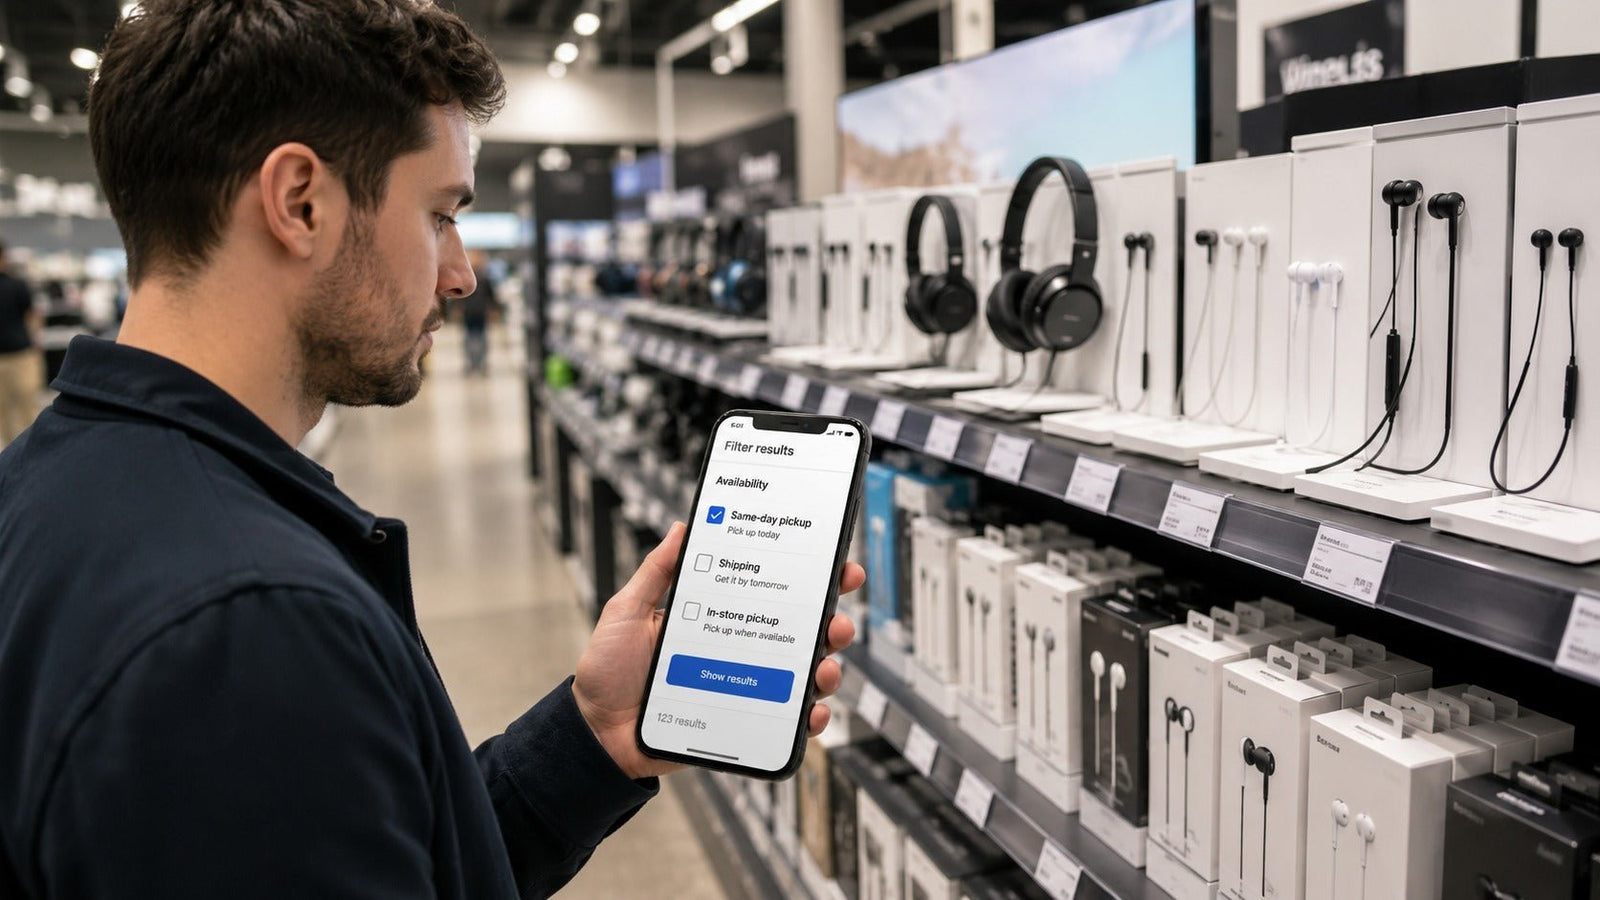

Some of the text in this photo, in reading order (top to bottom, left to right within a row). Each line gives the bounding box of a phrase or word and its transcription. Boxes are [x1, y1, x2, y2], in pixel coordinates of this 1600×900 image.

[725, 441, 794, 456] Filter results
[716, 476, 768, 491] Availability
[731, 511, 812, 529] Same-day pickup
[727, 526, 780, 541] Pick up today
[719, 559, 760, 573] Shipping
[715, 575, 789, 591] Get it by tomorrow
[707, 607, 779, 626] In-store pickup
[703, 624, 795, 644] Pick up when available
[700, 670, 758, 687] Show results
[657, 712, 706, 730] 123 results
